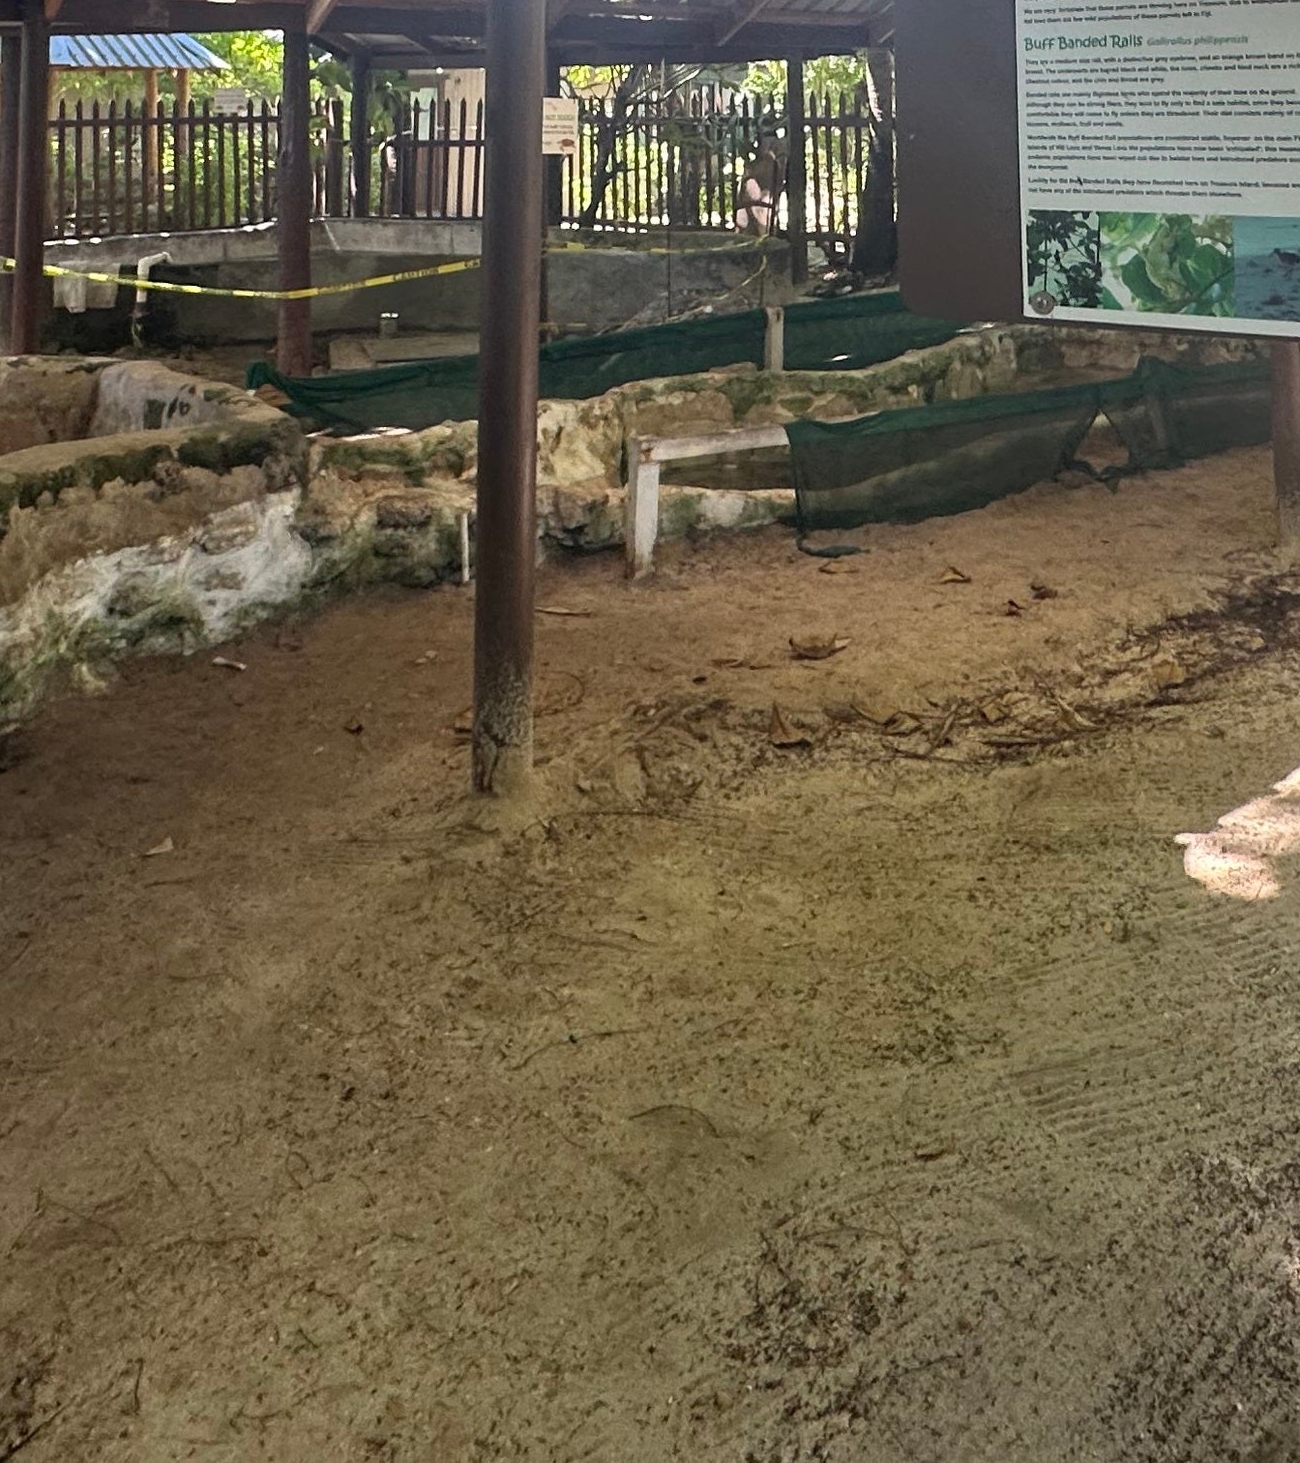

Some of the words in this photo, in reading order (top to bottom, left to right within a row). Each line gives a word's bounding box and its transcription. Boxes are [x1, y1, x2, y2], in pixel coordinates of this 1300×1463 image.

[1024, 36, 1054, 51] Buff
[1057, 35, 1107, 50] Banded
[1110, 34, 1143, 48] Rails
